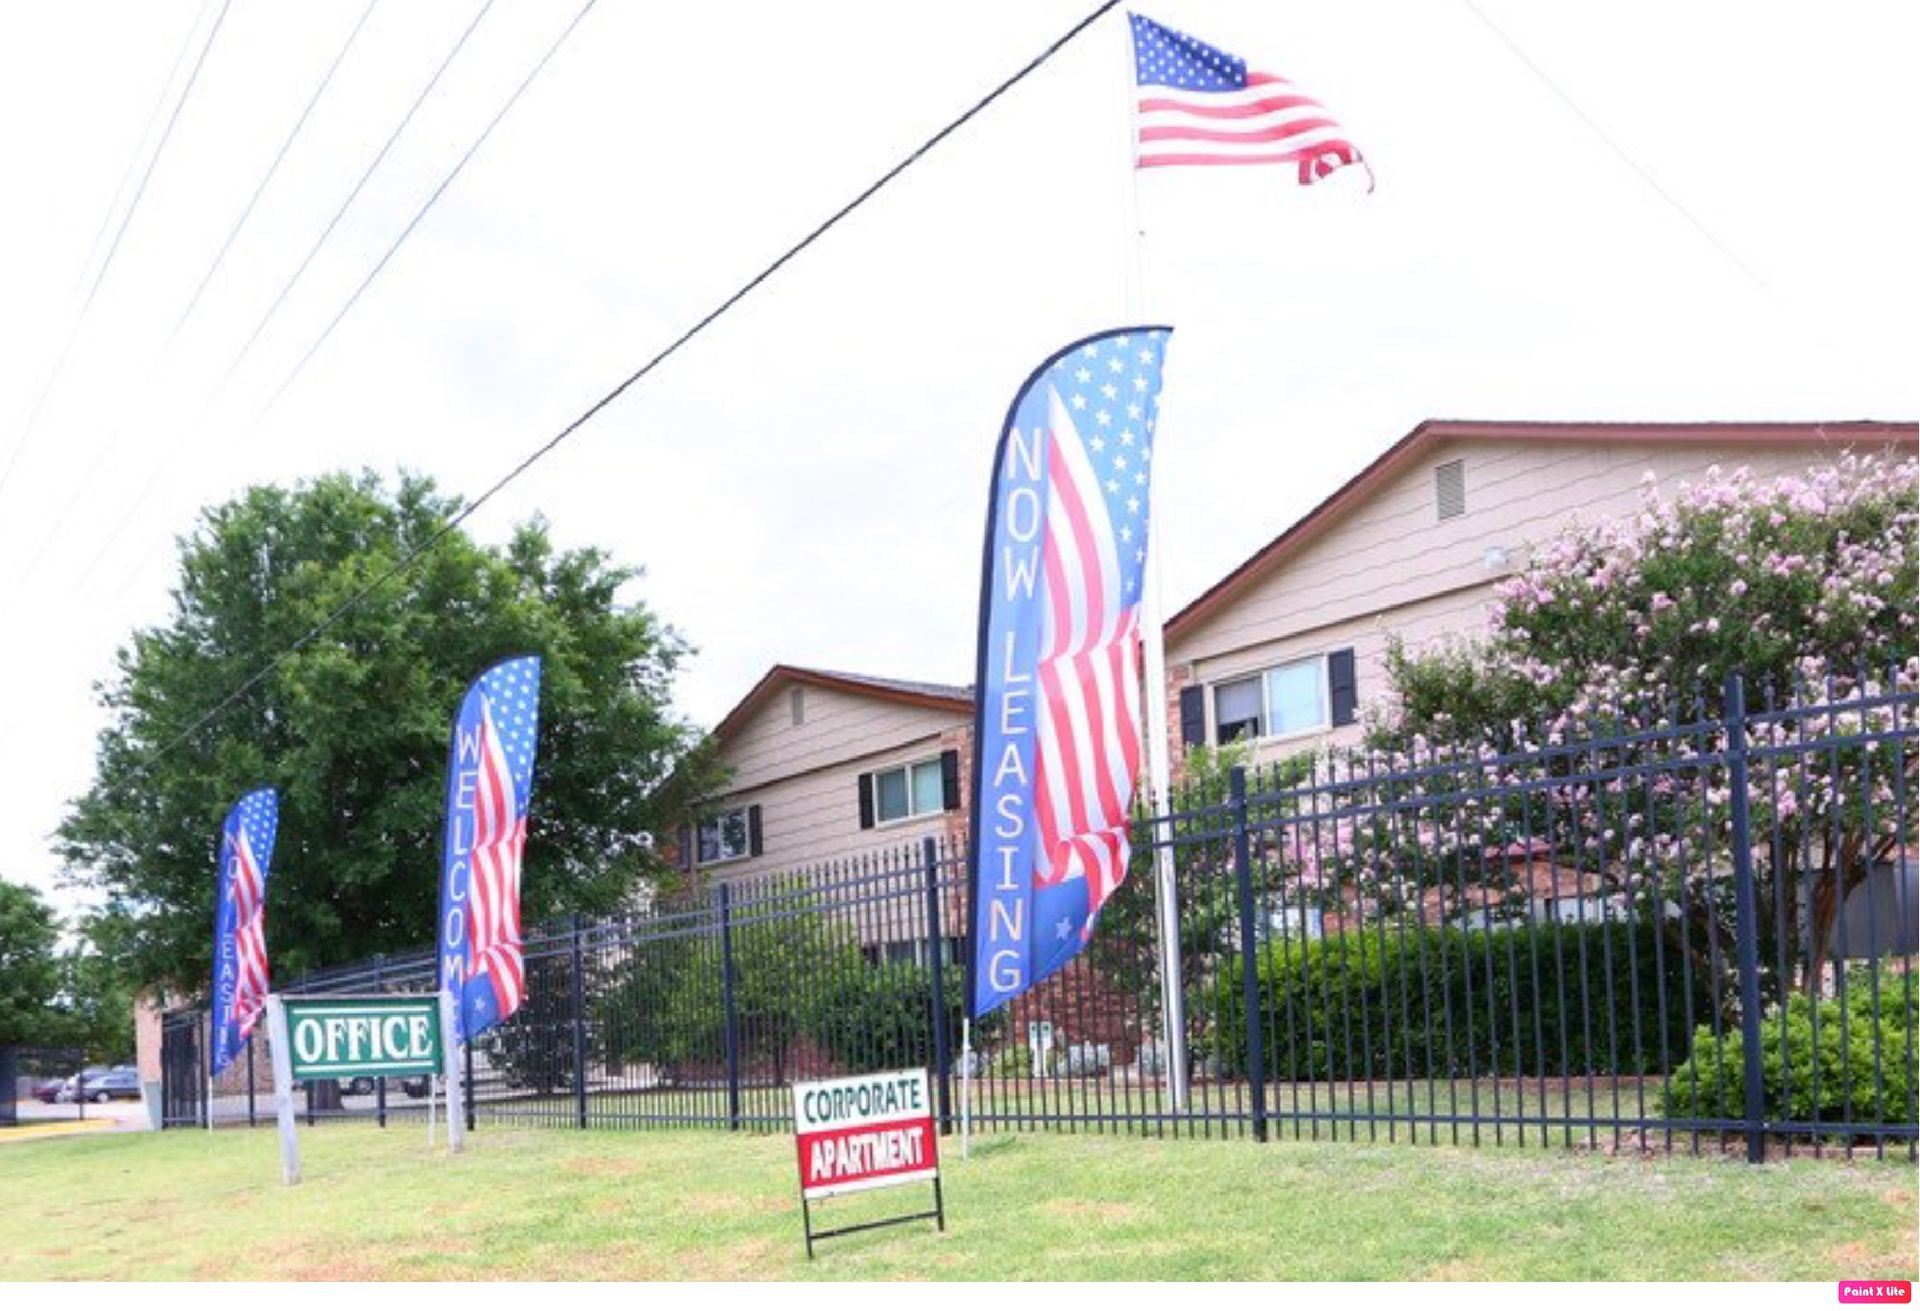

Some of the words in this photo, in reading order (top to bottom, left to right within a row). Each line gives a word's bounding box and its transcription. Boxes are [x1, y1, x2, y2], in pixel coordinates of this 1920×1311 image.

[1003, 427, 1042, 601] NOW
[988, 631, 1031, 993] LEASING
[445, 723, 482, 1044] WELCOM
[294, 1014, 433, 1063] OFFICE
[804, 1078, 922, 1123] CORPORATE
[810, 1126, 924, 1182] APARTMENT
